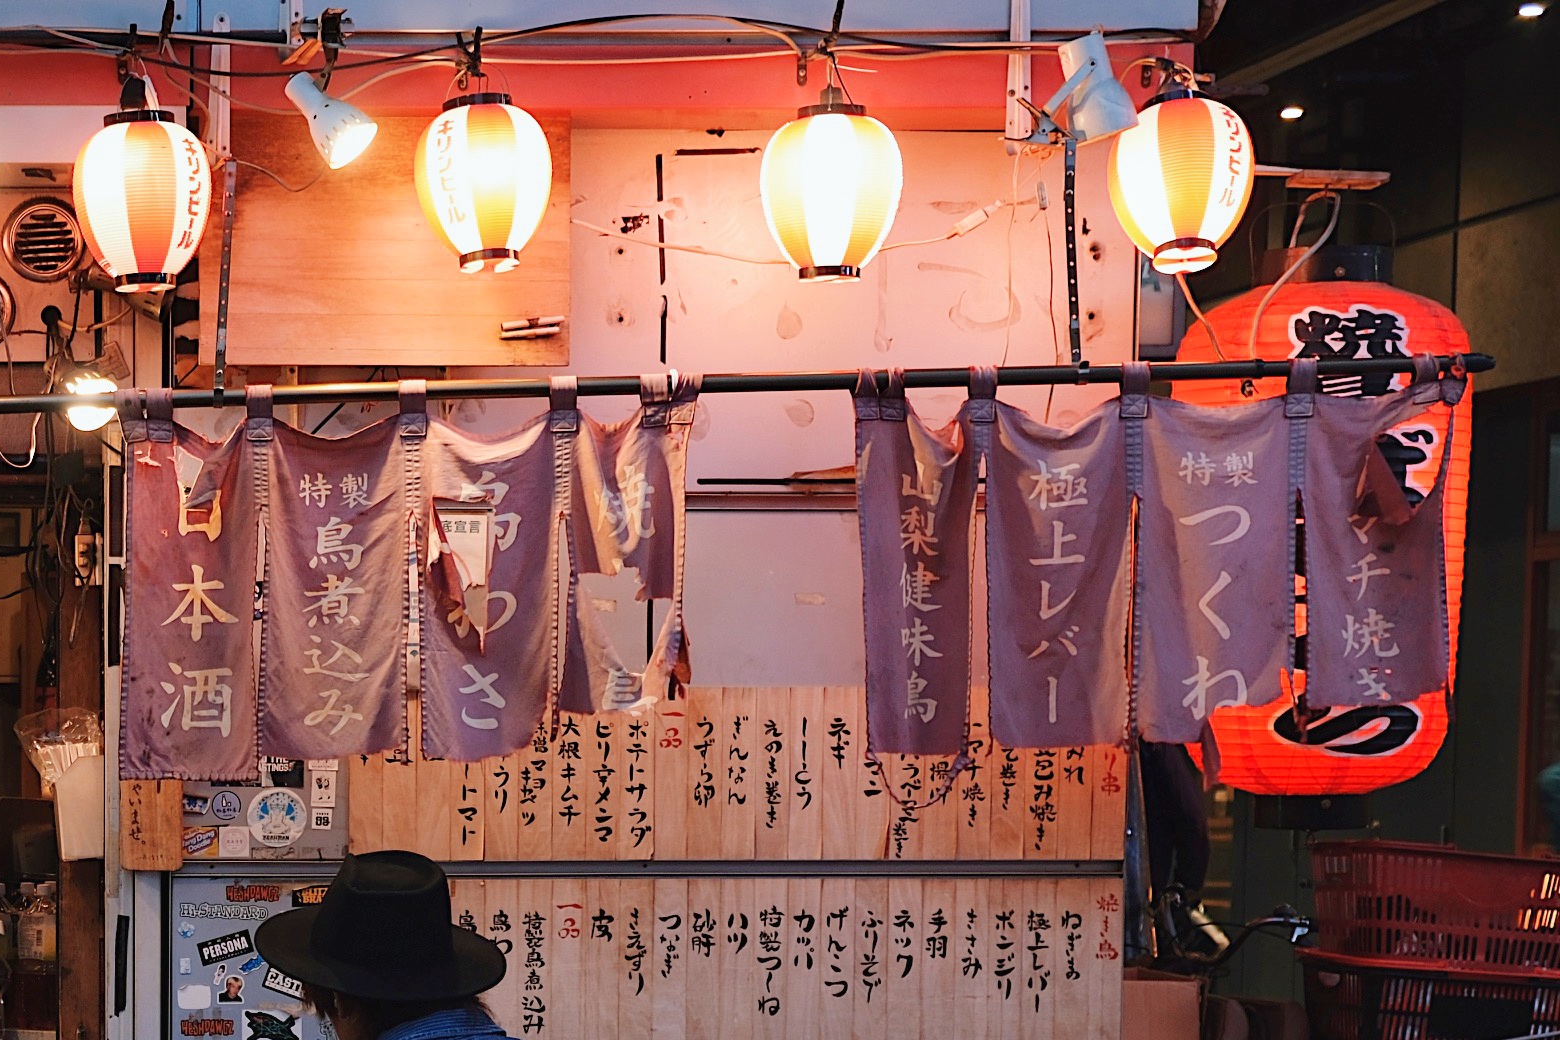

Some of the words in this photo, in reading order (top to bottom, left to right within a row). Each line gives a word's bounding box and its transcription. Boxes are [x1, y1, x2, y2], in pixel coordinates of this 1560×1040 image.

[180, 137, 203, 250] キリンビール
[437, 119, 466, 225] キリンビール
[1217, 105, 1243, 206] キリンビール
[299, 473, 371, 509] 特製
[1178, 450, 1257, 488] 特製
[160, 480, 238, 738] 日本酒
[303, 516, 370, 736] 鳥煮込み
[899, 461, 943, 724] 山梨健味鳥
[1028, 458, 1088, 724] 極上レバー
[1179, 505, 1252, 720] つくね
[558, 716, 582, 827] 大根キムチ
[659, 711, 686, 749] 一品
[693, 716, 715, 808] うずら卵
[727, 716, 749, 806] ぎんなん
[764, 719, 783, 829] えのき巻き
[827, 718, 851, 769] ネギ
[1064, 746, 1085, 785] みれ
[1101, 751, 1121, 797] り串
[128, 784, 147, 846] やいませ。
[493, 757, 510, 814] うり
[593, 721, 616, 842] ピリ辛メンマ
[625, 719, 652, 848] ポテトサラダ
[1030, 750, 1057, 850] 包み焼き
[180, 902, 268, 921] Hi-STANDARD
[203, 936, 248, 959] PERSONA
[556, 903, 583, 939] 一品
[591, 908, 615, 942] 皮
[624, 907, 647, 996] さえずり
[659, 913, 682, 979] つなぎ
[691, 908, 717, 958] 砂肝
[727, 912, 748, 955] ハツ
[793, 910, 815, 970] カッパ
[825, 906, 849, 998] げんこつ
[893, 909, 915, 979] ネック
[925, 908, 948, 959] 手羽
[961, 908, 982, 979] ささみ
[994, 909, 1015, 1000] ボンジリ
[1096, 893, 1119, 960] 焼き鳥
[522, 911, 547, 1035] 特製鳥煮込み
[757, 905, 785, 1017] 特製つくね
[860, 910, 884, 1003] ふりそで
[1026, 910, 1051, 1013] 極上レバー
